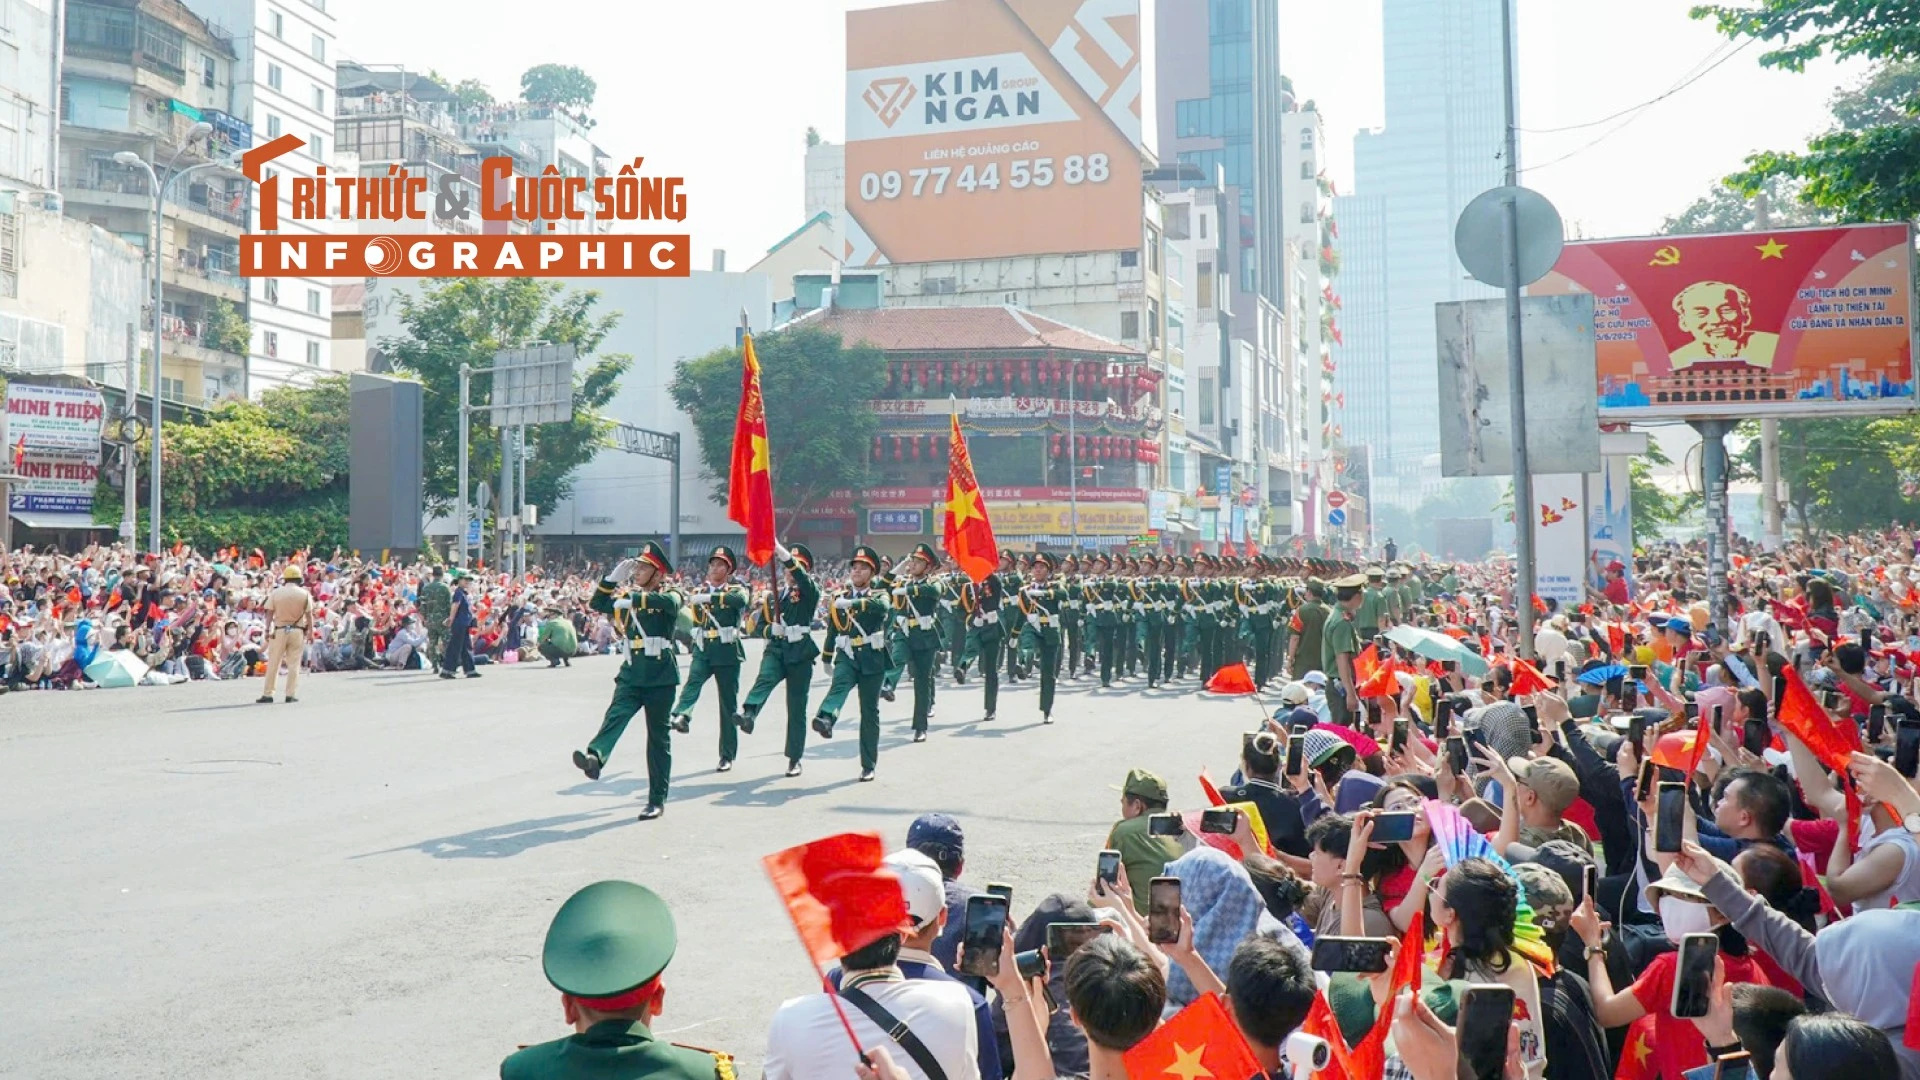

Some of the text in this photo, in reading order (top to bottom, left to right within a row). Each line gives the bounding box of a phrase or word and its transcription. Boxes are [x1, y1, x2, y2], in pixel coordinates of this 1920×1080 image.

[925, 67, 1039, 98] KIM GROUP
[925, 90, 1040, 124] NGAN
[924, 140, 1040, 160] LIÊN HỆ QUẢNG CÁO
[860, 153, 1110, 201] 09 77 44 55 88
[1799, 287, 1816, 299] CHỦ
[1818, 288, 1837, 298] TỊCH
[1839, 287, 1850, 297] HỒ
[1870, 286, 1892, 296] MINH
[1846, 301, 1870, 312] THIÊN
[1627, 318, 1651, 328] NƯỚC
[1791, 316, 1807, 329] CỦA
[1848, 316, 1872, 327] NHÂN
[8, 397, 102, 423] MINH THIỆN
[55, 460, 99, 483] THIỆN
[12, 495, 26, 509] 2
[33, 496, 55, 505] PHẠM
[56, 495, 77, 505] HỒNG
